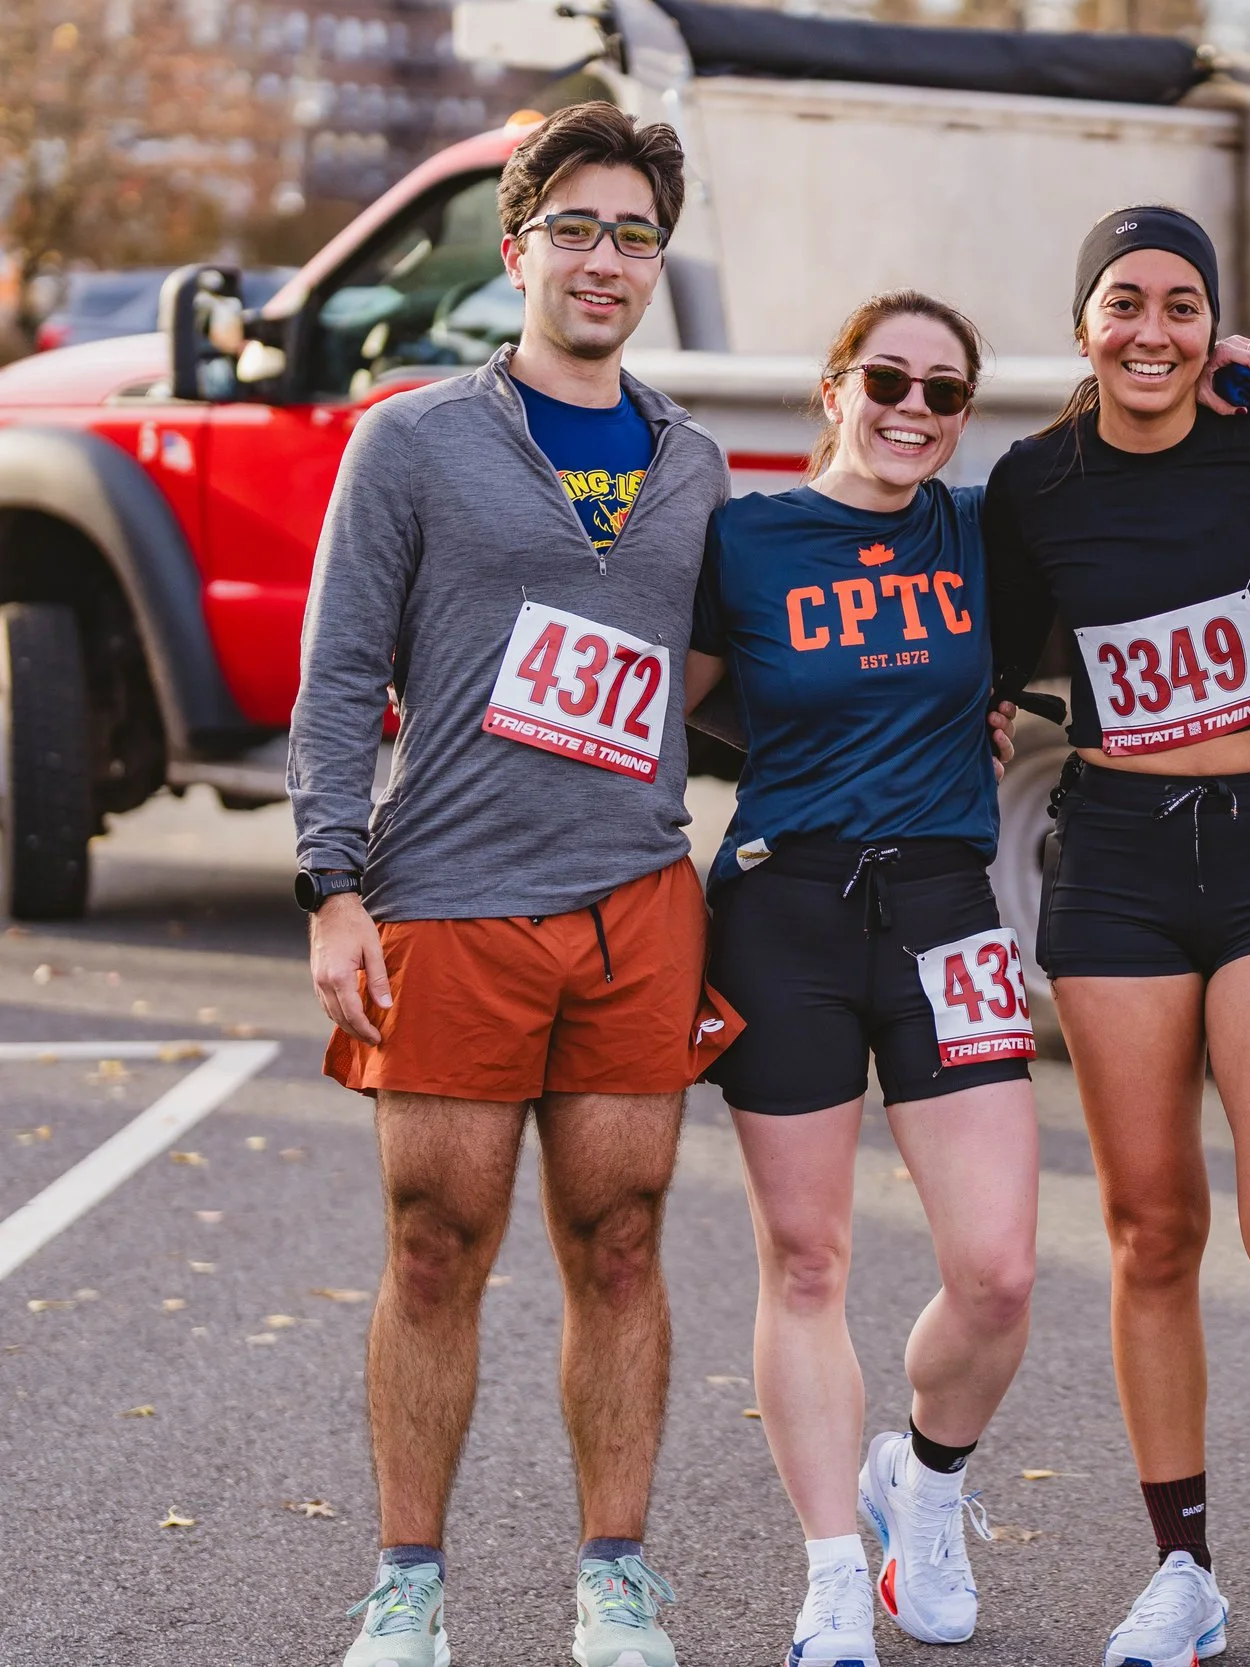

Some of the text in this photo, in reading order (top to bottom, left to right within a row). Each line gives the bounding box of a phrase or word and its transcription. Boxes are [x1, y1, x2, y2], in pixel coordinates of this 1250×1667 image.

[1115, 221, 1138, 235] alo
[786, 571, 972, 651] CPTC
[517, 621, 661, 740] 4372
[860, 650, 930, 669] EST. 1972
[1097, 616, 1247, 717] 3349
[491, 713, 652, 775] TRISTATE TIMING
[1109, 725, 1185, 748] TRISTATE
[947, 1037, 1024, 1058] TRISTATE
